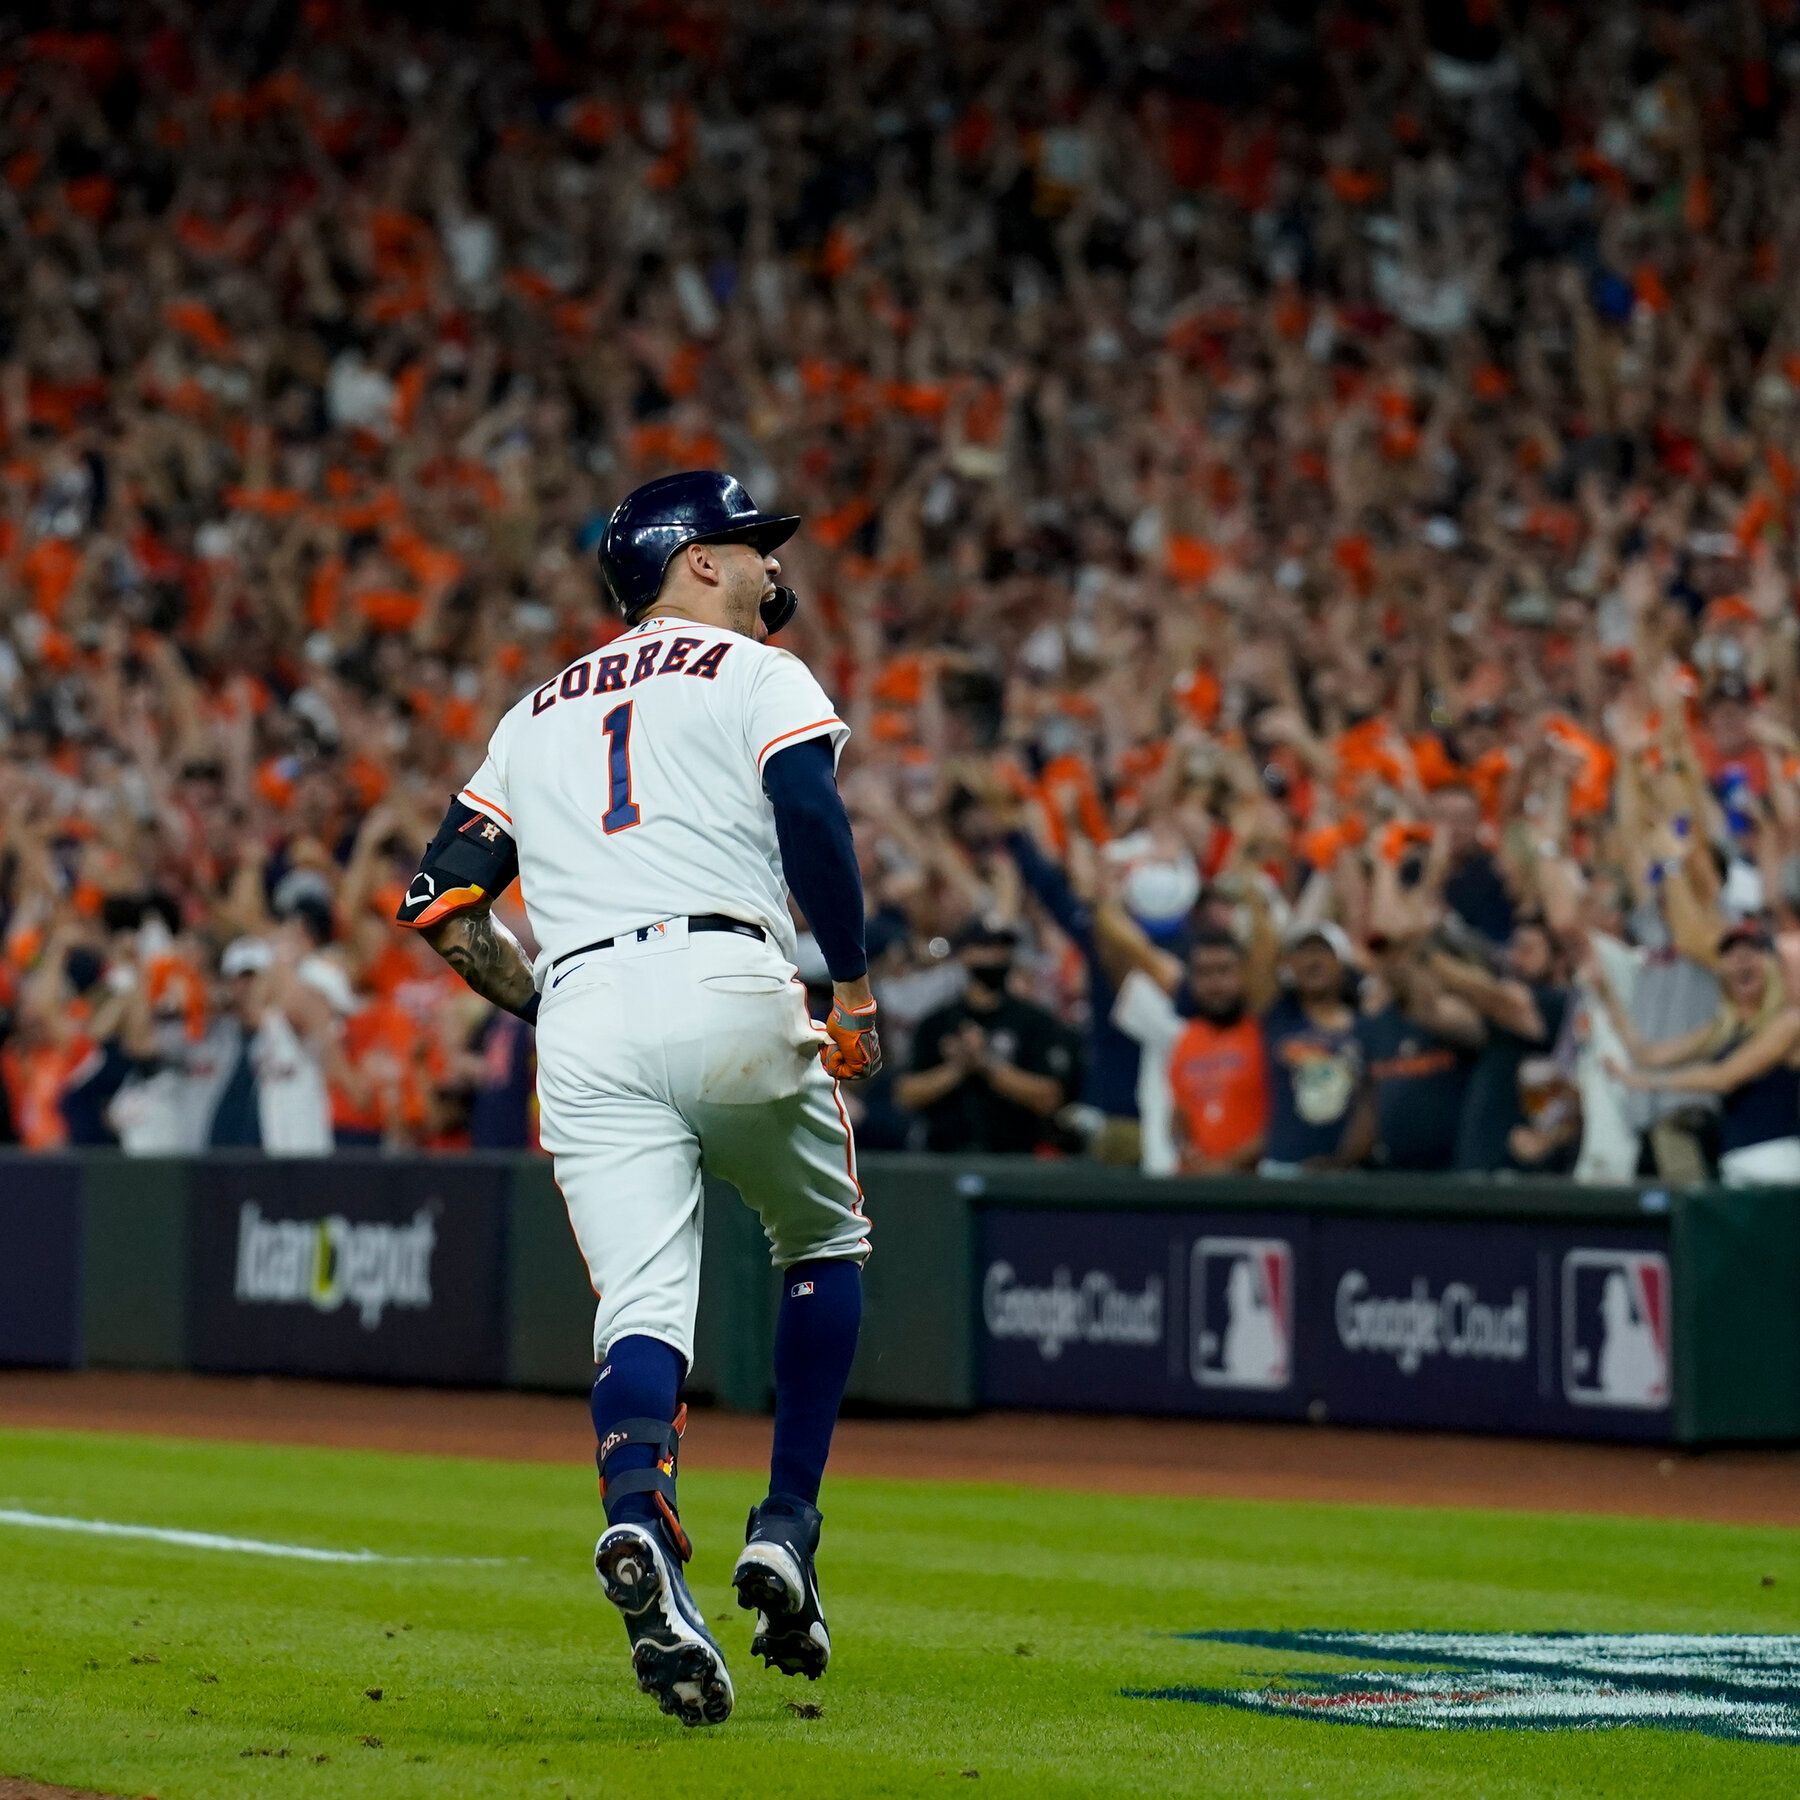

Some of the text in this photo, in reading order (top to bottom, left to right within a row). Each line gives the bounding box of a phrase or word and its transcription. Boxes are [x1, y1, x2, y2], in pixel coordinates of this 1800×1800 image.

[532, 637, 734, 717] CORREA
[602, 699, 641, 835] 1
[983, 1260, 1163, 1359] Google Cloud
[1335, 1270, 1529, 1376] Google Cloud
